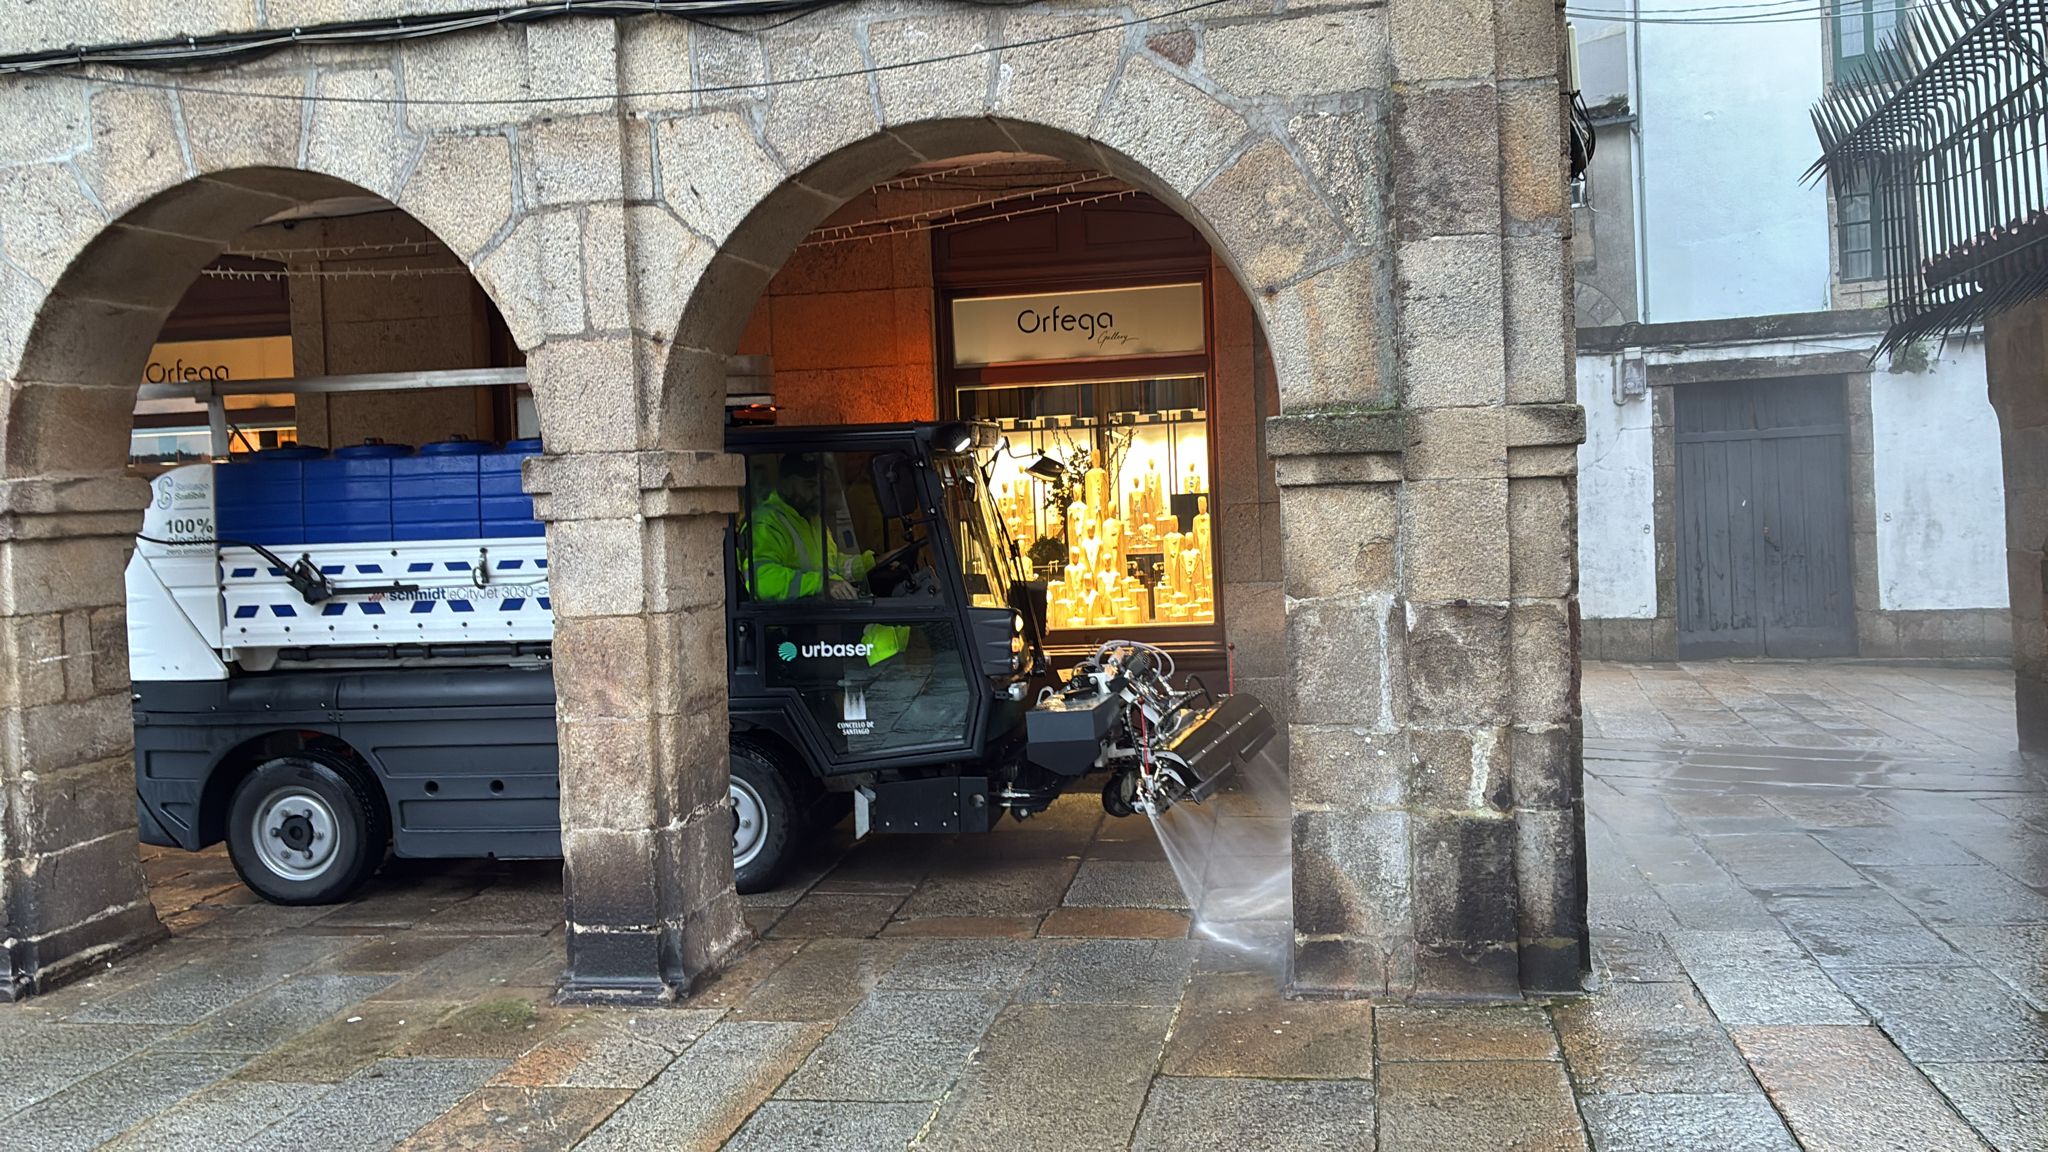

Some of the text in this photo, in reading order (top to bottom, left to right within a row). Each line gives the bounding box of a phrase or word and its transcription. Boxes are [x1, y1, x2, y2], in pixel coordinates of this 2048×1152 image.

[1018, 306, 1113, 340] Orfega
[1097, 331, 1139, 349] Gallery
[165, 518, 213, 536] 100%
[390, 587, 446, 601] schmidt
[502, 585, 533, 599] 3030
[801, 640, 874, 658] urbaser
[837, 721, 875, 730] CONCELLO DE
[842, 728, 870, 736] SANTIAGO
